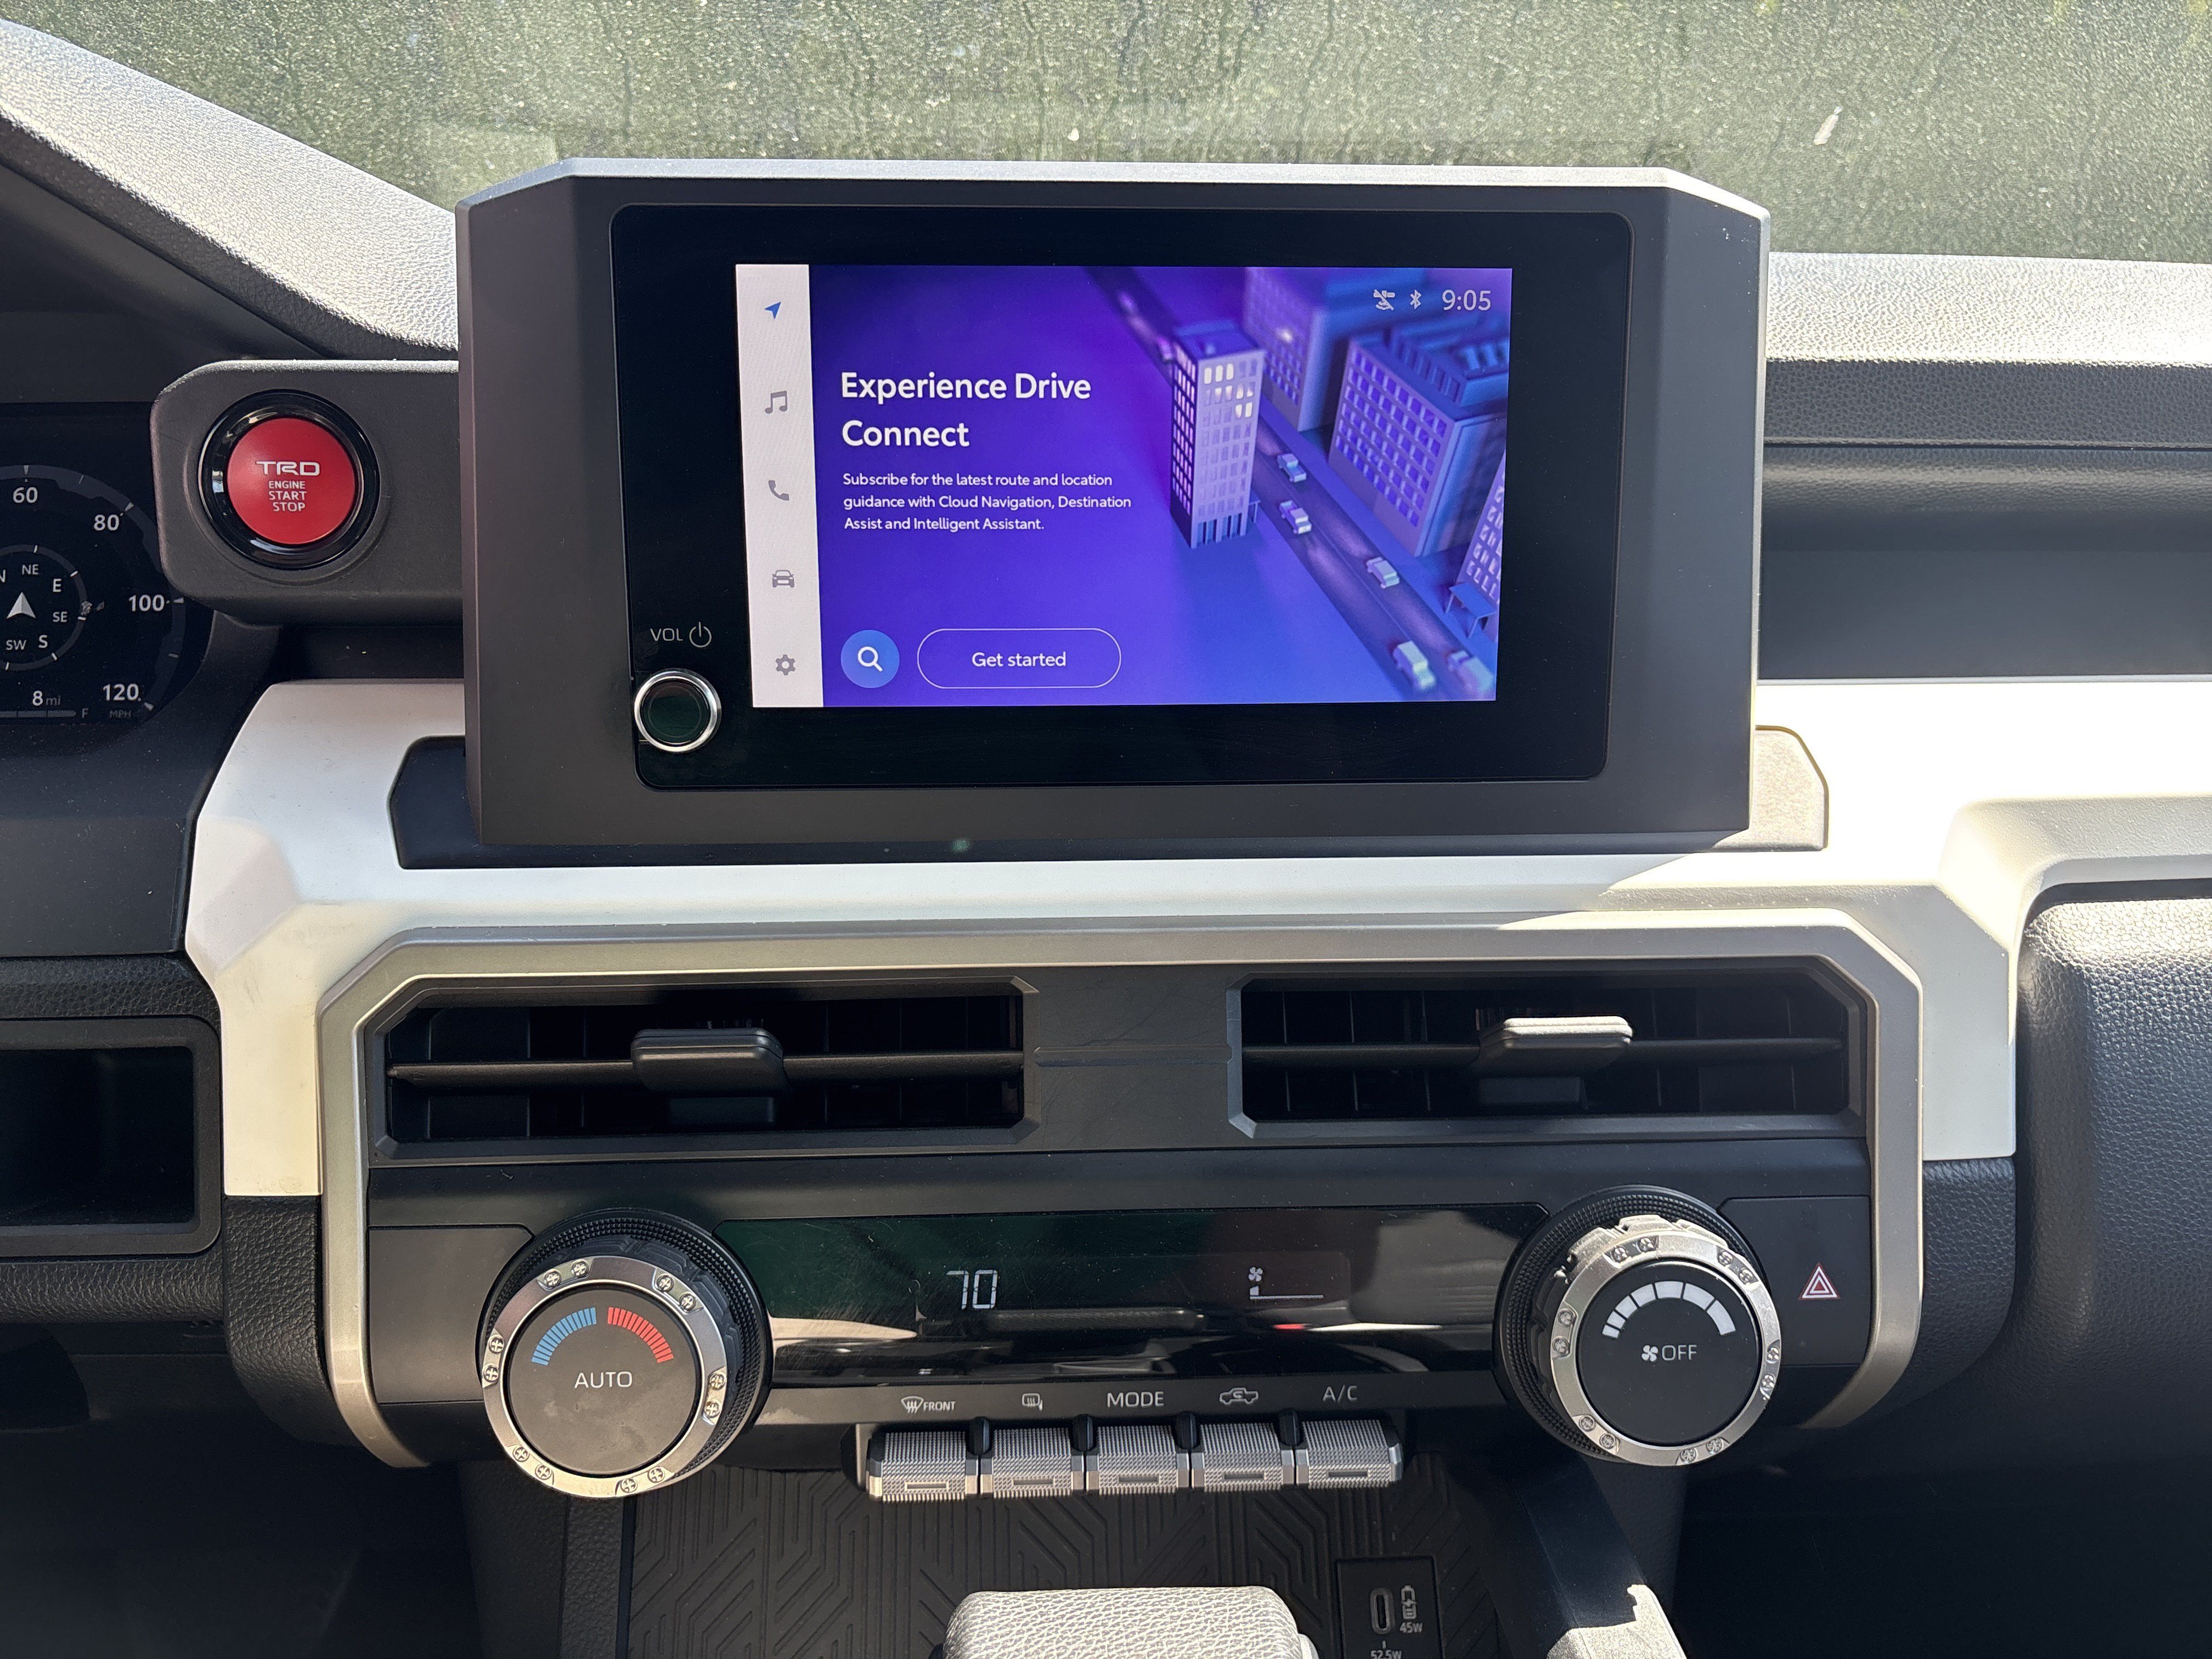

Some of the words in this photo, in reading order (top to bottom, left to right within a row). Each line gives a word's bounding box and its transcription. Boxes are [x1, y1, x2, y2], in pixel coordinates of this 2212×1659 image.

[1442, 289, 1491, 311] 9:05
[842, 371, 1007, 405] Experience
[1015, 372, 1091, 399] Drive
[842, 420, 970, 447] Connect
[255, 461, 320, 476] TRD
[268, 480, 306, 489] ENGINE
[843, 472, 909, 486] Subscribe
[910, 472, 929, 486] for
[931, 473, 953, 486] the
[956, 473, 994, 486] latest
[995, 475, 1030, 486] route
[1032, 473, 1058, 486] and
[1062, 473, 1113, 486] location
[13, 487, 38, 504] 60
[268, 490, 307, 500] START
[843, 494, 905, 510] guidance
[907, 495, 935, 507] with
[939, 495, 978, 508] Cloud
[981, 495, 1055, 511] Navigation,
[1058, 495, 1131, 508] Destination
[273, 501, 306, 512] STOP
[94, 514, 120, 531] 80
[844, 517, 883, 529] Assist
[884, 517, 911, 529] and
[913, 517, 980, 533] Intelligent
[982, 517, 1045, 530] Assistant.
[21, 563, 39, 575] NE
[53, 578, 61, 592] E
[128, 594, 165, 612] 100
[53, 611, 67, 623] SE
[38, 634, 48, 648] S
[650, 628, 684, 641] VOL
[5, 639, 27, 651] SW
[972, 652, 1004, 667] Get
[1008, 651, 1066, 667] started
[32, 690, 43, 706] 8
[46, 695, 61, 706] mi
[103, 683, 139, 701] 120
[81, 708, 89, 719] F
[946, 1269, 998, 1310] 70
[1662, 1344, 1697, 1361] OFF
[574, 1371, 633, 1389] AUTO
[1107, 1391, 1164, 1408] MODE
[1323, 1385, 1357, 1402] A/C
[923, 1401, 956, 1411] FRONT
[1400, 1622, 1423, 1633] 45W
